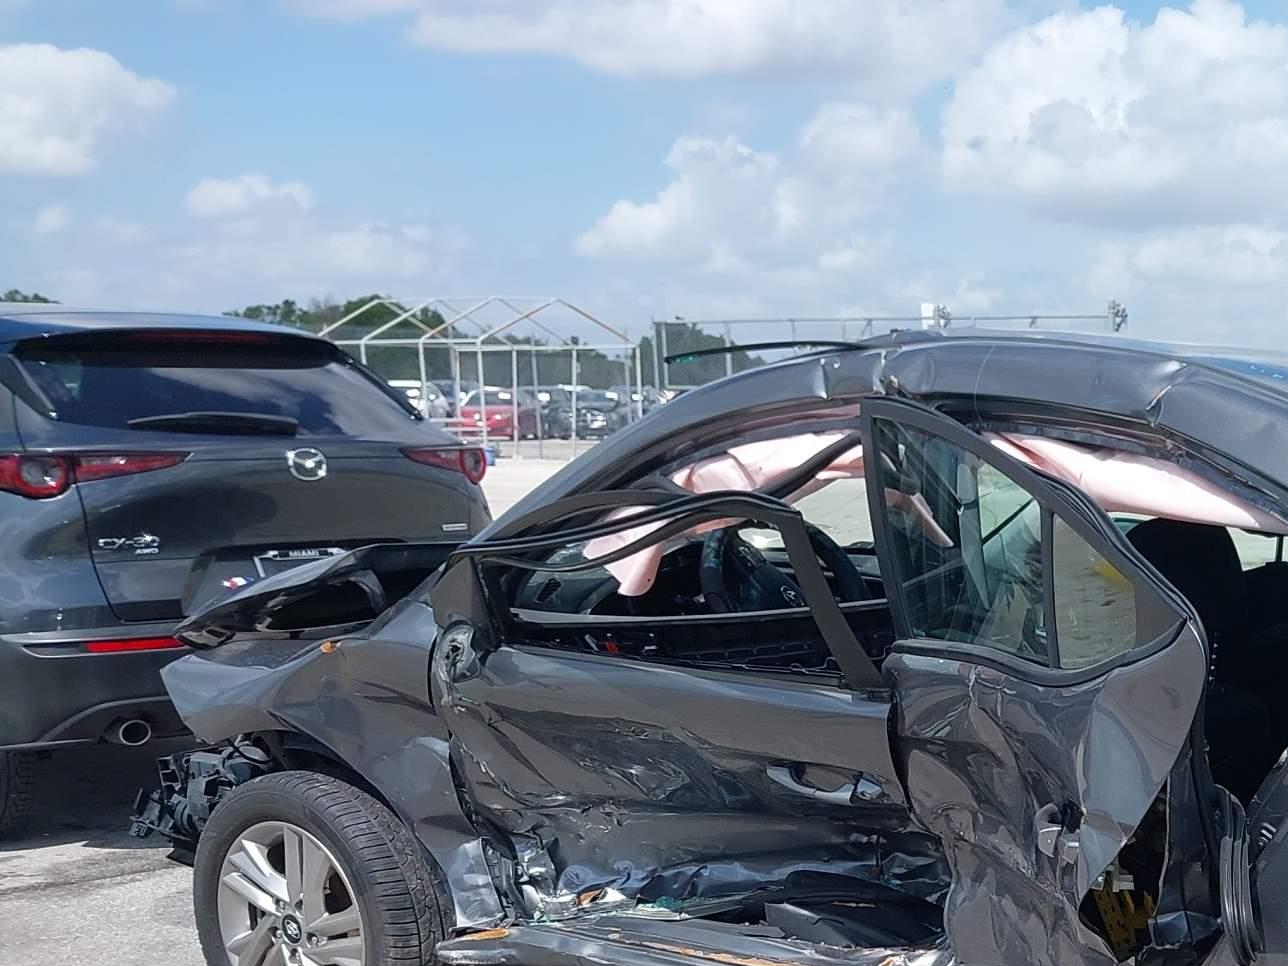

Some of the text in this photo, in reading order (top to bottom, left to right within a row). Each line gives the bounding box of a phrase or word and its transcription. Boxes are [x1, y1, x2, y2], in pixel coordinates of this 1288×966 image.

[98, 535, 160, 549] CX-30
[135, 547, 159, 555] AWD
[288, 549, 320, 558] MIAMI
